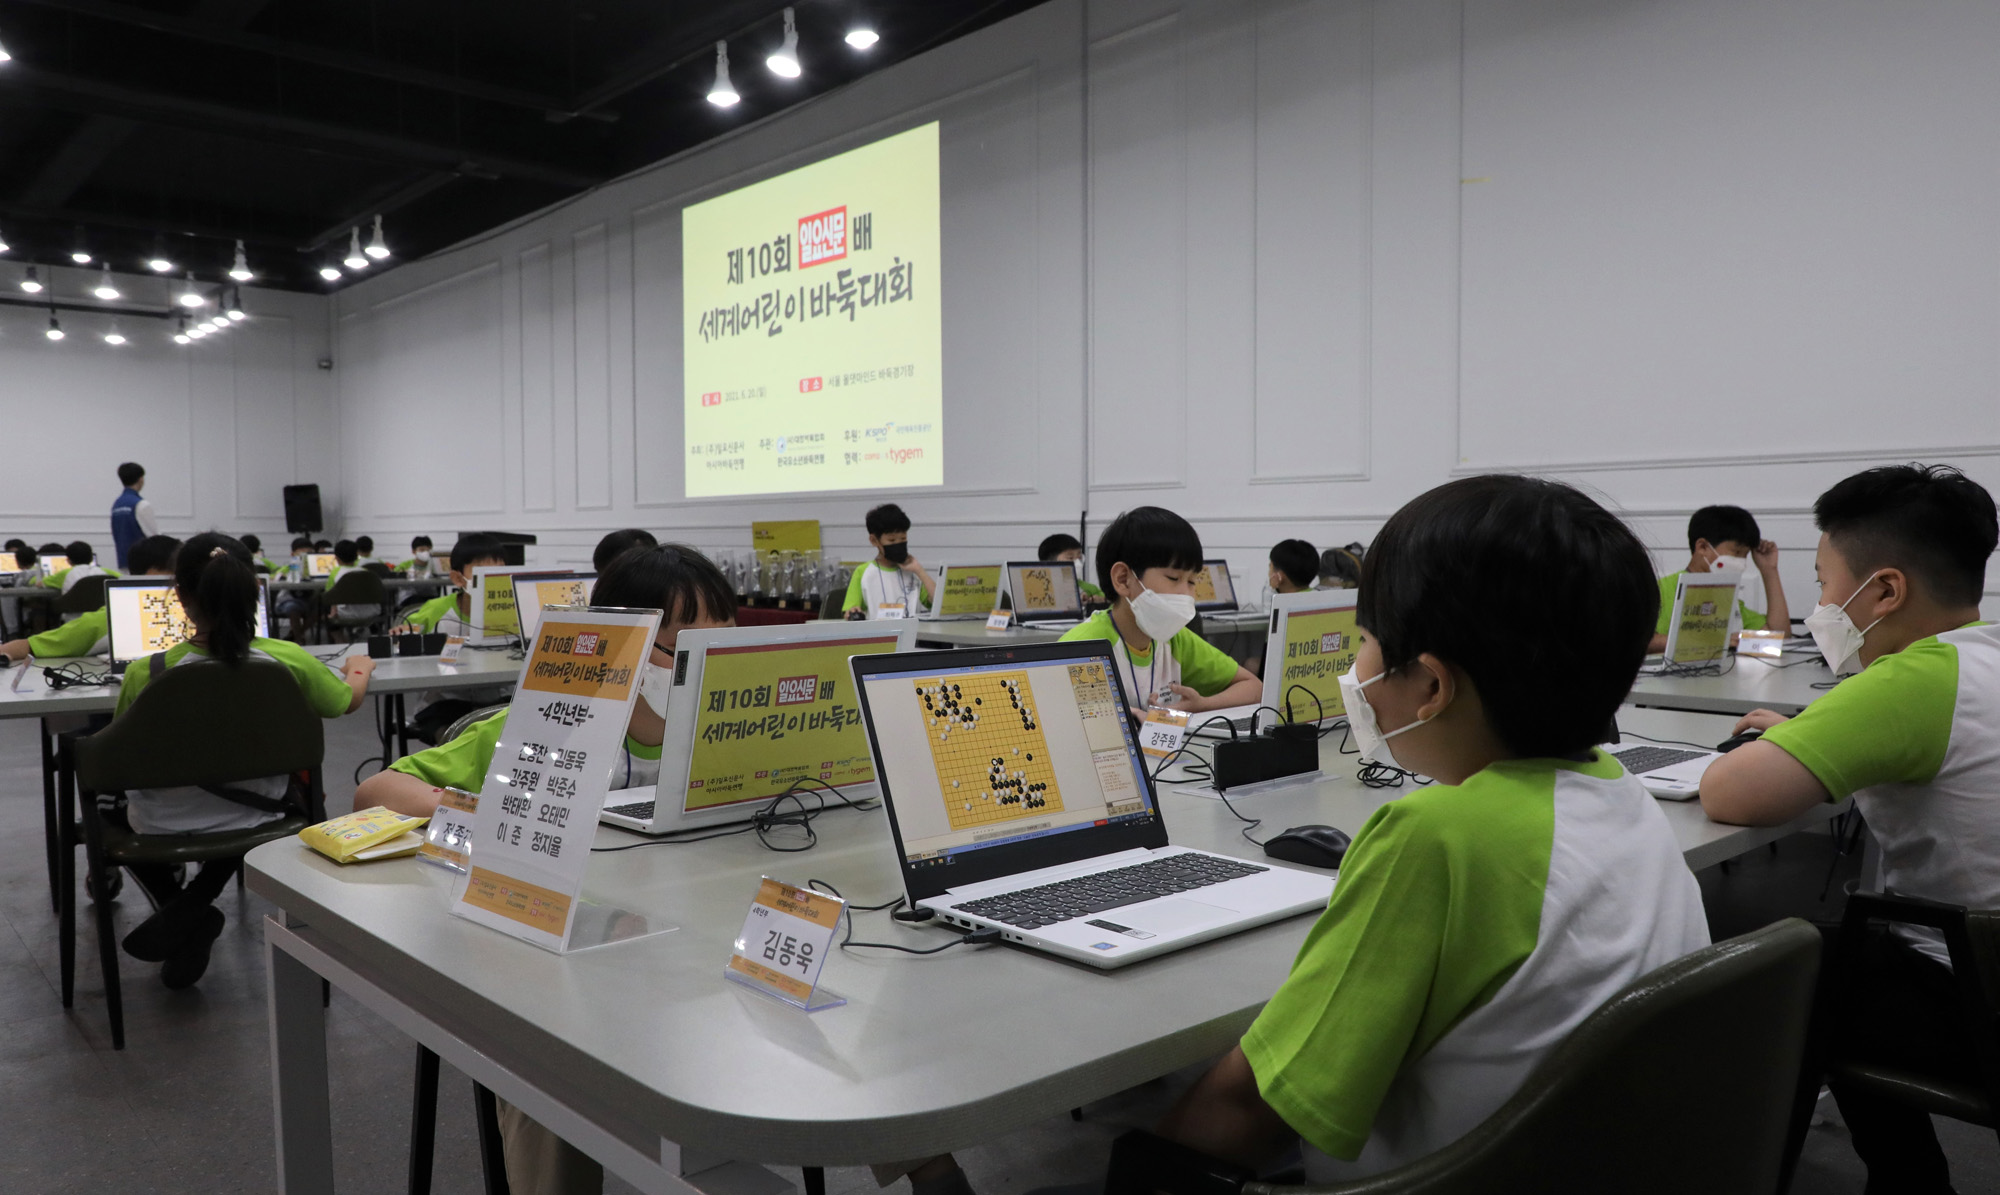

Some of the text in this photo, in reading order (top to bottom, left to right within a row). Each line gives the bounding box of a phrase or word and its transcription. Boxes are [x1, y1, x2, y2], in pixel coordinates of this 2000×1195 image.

[728, 234, 790, 284] 제10회
[853, 213, 872, 251] 배
[878, 364, 914, 380] 바둑경기장
[865, 427, 888, 438] KSPO
[890, 448, 924, 464] tygem
[541, 635, 574, 656] 제10회
[596, 639, 608, 657] 배
[1288, 638, 1318, 658] 제10회
[676, 652, 688, 685] Lenovo
[1286, 654, 1356, 681] 세계어린이바둑
[706, 678, 836, 712] 제10회 일요신문 배
[702, 705, 864, 744] 세계어린이바둑대
[1151, 732, 1178, 749] 강주원
[554, 748, 586, 772] 김동욱
[851, 766, 870, 776] tygem
[509, 768, 576, 799] 강주원 박준수
[537, 804, 570, 828] 오태민
[762, 930, 814, 974] 김동욱
